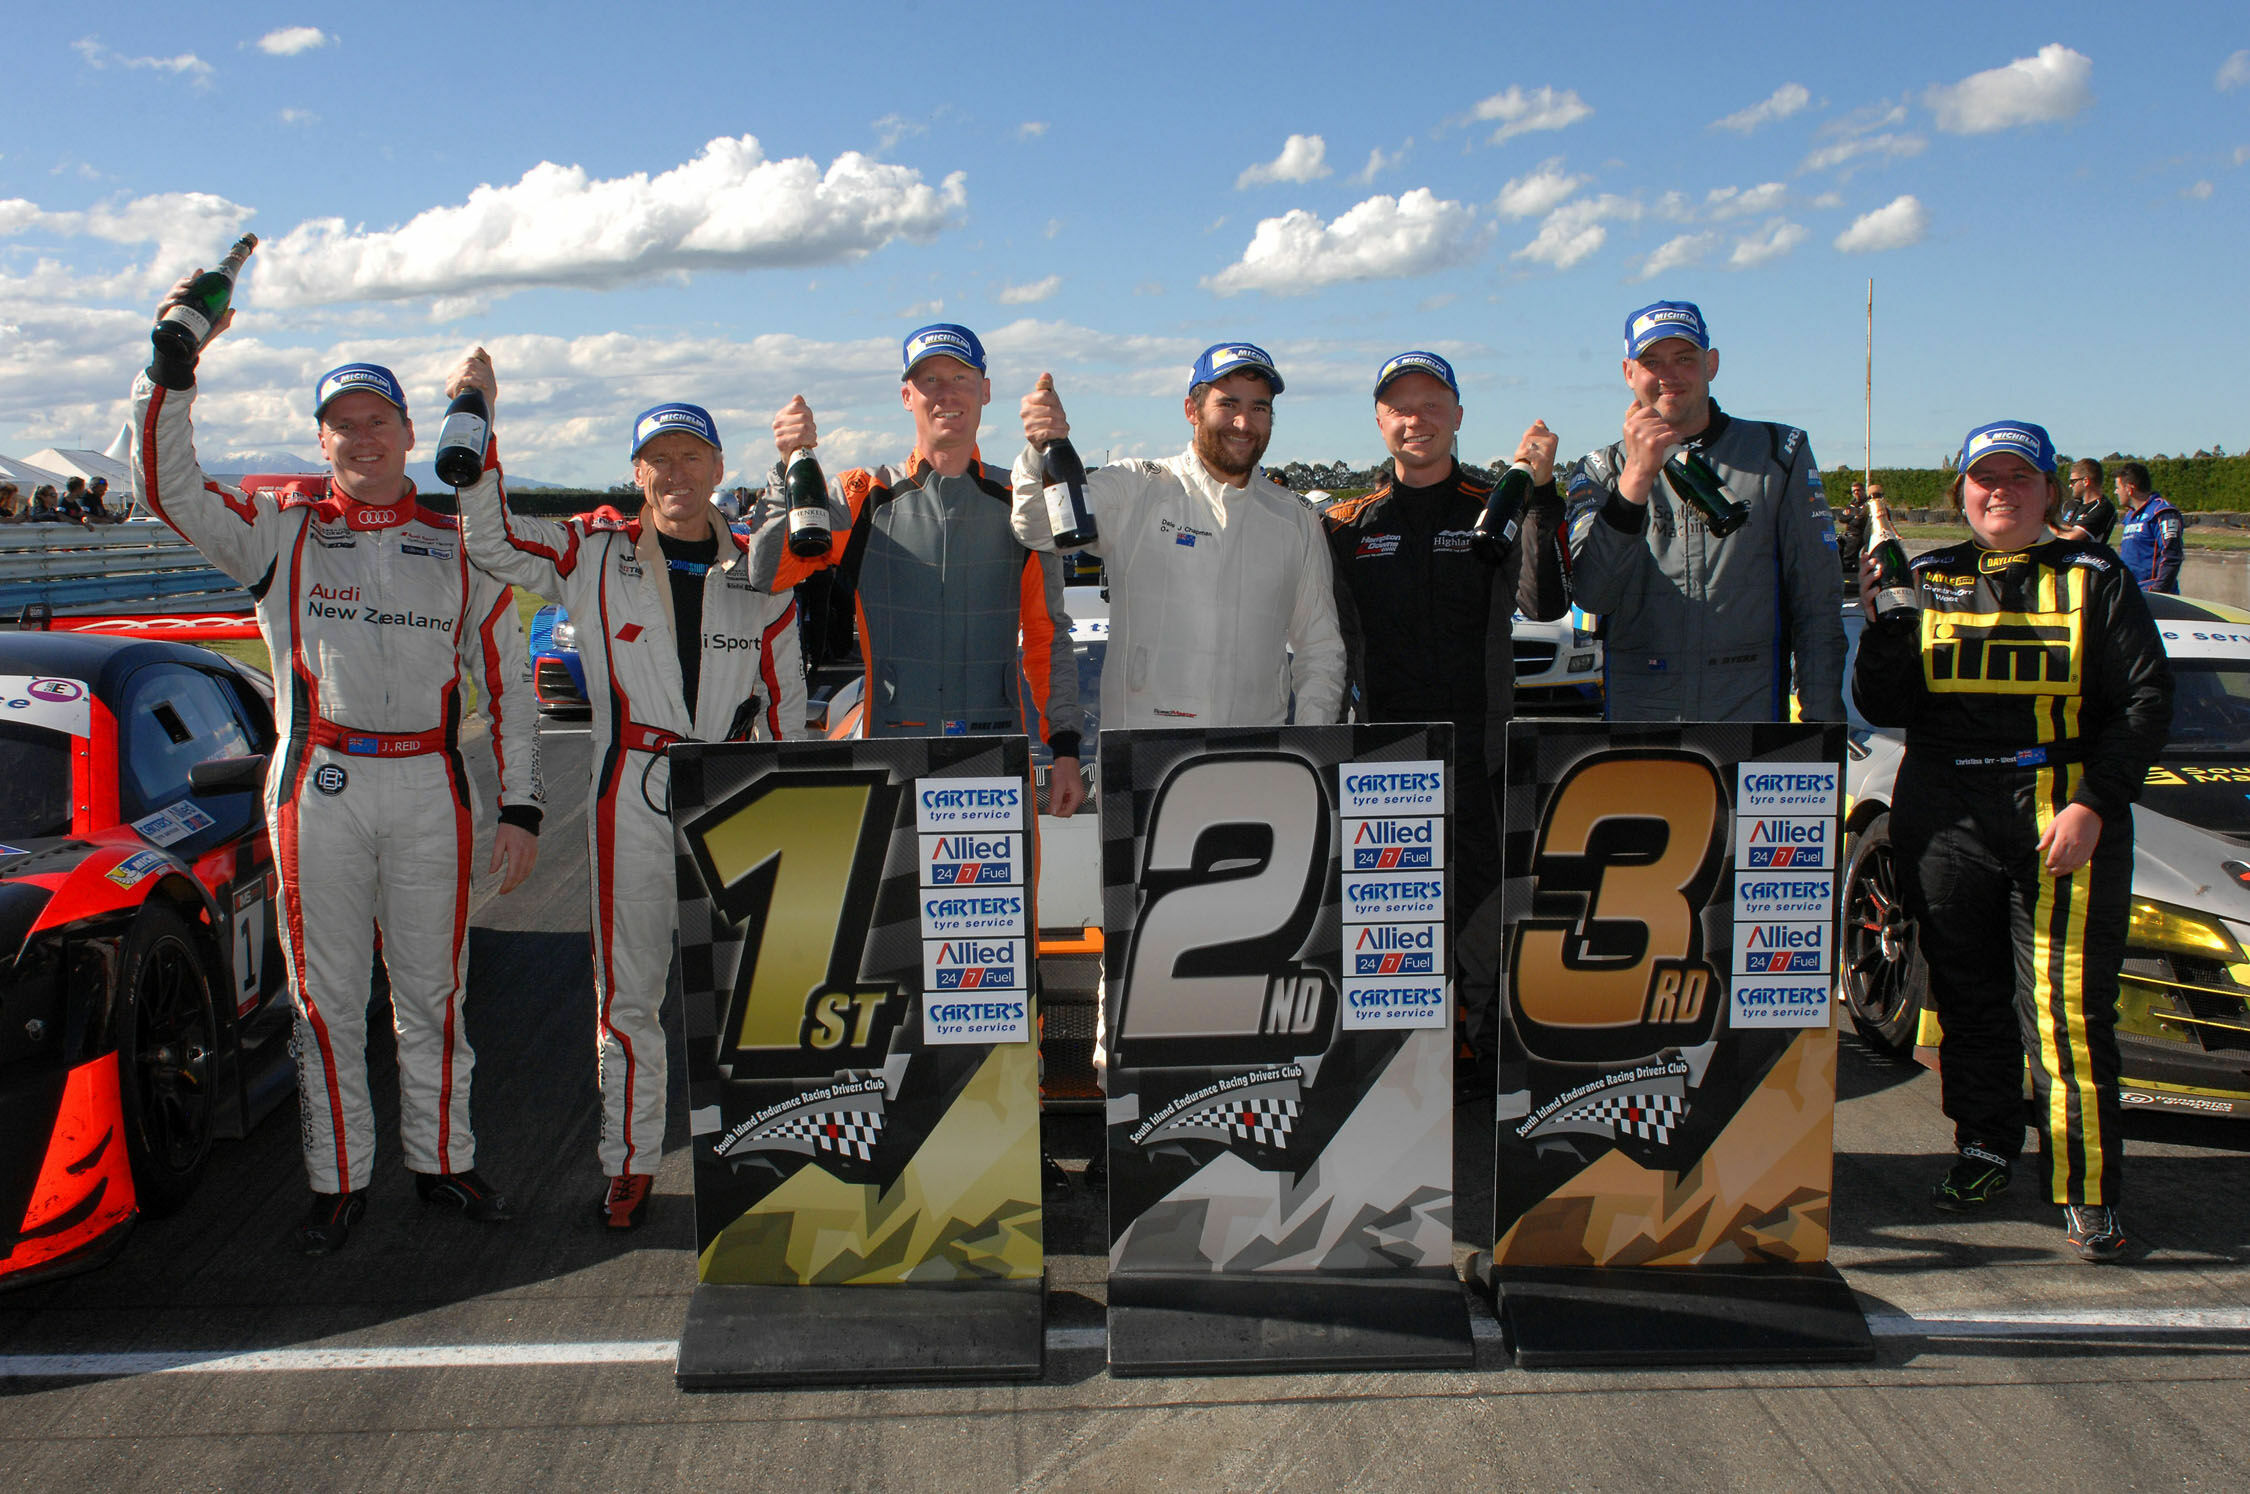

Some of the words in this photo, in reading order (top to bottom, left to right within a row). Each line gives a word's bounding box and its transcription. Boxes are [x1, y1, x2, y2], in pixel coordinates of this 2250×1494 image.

[1654, 311, 1697, 325] MICHELIN
[925, 334, 970, 349] MICHELIN
[1401, 357, 1445, 372] MICHELIN
[340, 373, 388, 387] MICHELIN
[659, 413, 706, 428] MICHELIN
[1992, 431, 2039, 448] MICHELIN
[1162, 518, 1175, 528] Dale
[1184, 526, 1213, 537] Chapman
[1361, 535, 1401, 544] Hampton
[308, 583, 360, 601] Audi
[308, 601, 357, 620] New
[363, 606, 454, 632] Zealand
[712, 634, 762, 652] Sport
[381, 741, 420, 752] J.REID
[1346, 773, 1440, 794] CARTER'S
[1744, 774, 1835, 793] CARTER'S
[921, 789, 1018, 809] CARTER'S
[1354, 796, 1378, 806] tyre
[1384, 794, 1432, 804] service
[1750, 795, 1774, 805] tyre
[1780, 795, 1826, 803] service
[930, 811, 955, 821] tyre
[962, 810, 1010, 819] service
[1353, 819, 1432, 844] Allied
[1749, 820, 1825, 843] Allied
[932, 836, 1010, 860] Allied
[1359, 854, 1374, 863] 24
[1386, 853, 1393, 863] 7
[1404, 852, 1428, 862] Fuel
[1754, 852, 1767, 862] 24
[1780, 852, 1786, 861] 7
[1797, 852, 1820, 862] Fuel
[938, 869, 952, 879] 24
[965, 868, 972, 878] 7
[983, 867, 1007, 878] Fuel
[1347, 881, 1442, 902] CARTER'S
[1740, 881, 1830, 901] CARTER'S
[925, 897, 1021, 918] CARTER'S
[1356, 905, 1380, 914] tyre
[1386, 902, 1433, 912] service
[1747, 903, 1771, 913] tyre
[1776, 902, 1822, 911] service
[934, 921, 959, 930] tyre
[966, 918, 1013, 927] service
[1354, 925, 1433, 950] Allied
[1747, 925, 1822, 948] Allied
[241, 917, 256, 992] 1
[935, 940, 1014, 964] Allied
[1361, 959, 1375, 969] 24
[1388, 958, 1394, 968] 7
[1405, 957, 1429, 968] Fuel
[1751, 957, 1765, 967] 24
[1777, 957, 1783, 966] 7
[1794, 956, 1817, 966] Fuel
[942, 974, 956, 984] 24
[969, 973, 975, 983] 7
[987, 972, 1011, 982] Fuel
[1349, 988, 1442, 1008] CARTER'S
[1736, 987, 1827, 1007] CARTER'S
[929, 1002, 1024, 1023] CARTER'S
[1356, 1010, 1381, 1020] tyre
[1387, 1008, 1434, 1017] service
[1743, 1009, 1767, 1018] tyre
[1773, 1008, 1819, 1016] service
[936, 1023, 962, 1034] tyre
[967, 1021, 1016, 1032] service
[1129, 1122, 1152, 1144] South
[1150, 1103, 1174, 1126] Island
[1173, 1084, 1218, 1108] Endurance
[1218, 1075, 1249, 1092] Racing
[1249, 1069, 1280, 1084] Drivers
[1281, 1066, 1302, 1077] Club
[1516, 1117, 1538, 1138] South
[1537, 1100, 1561, 1121] Island
[1560, 1079, 1605, 1104] Endurance
[1605, 1070, 1635, 1086] Racing
[1636, 1065, 1666, 1079] Drivers
[1667, 1062, 1688, 1074] Club
[713, 1135, 736, 1156] South
[734, 1115, 758, 1137] Island
[757, 1096, 801, 1120] Endurance
[801, 1088, 831, 1103] Racing
[832, 1081, 862, 1096] Drivers
[864, 1078, 885, 1091] Club
